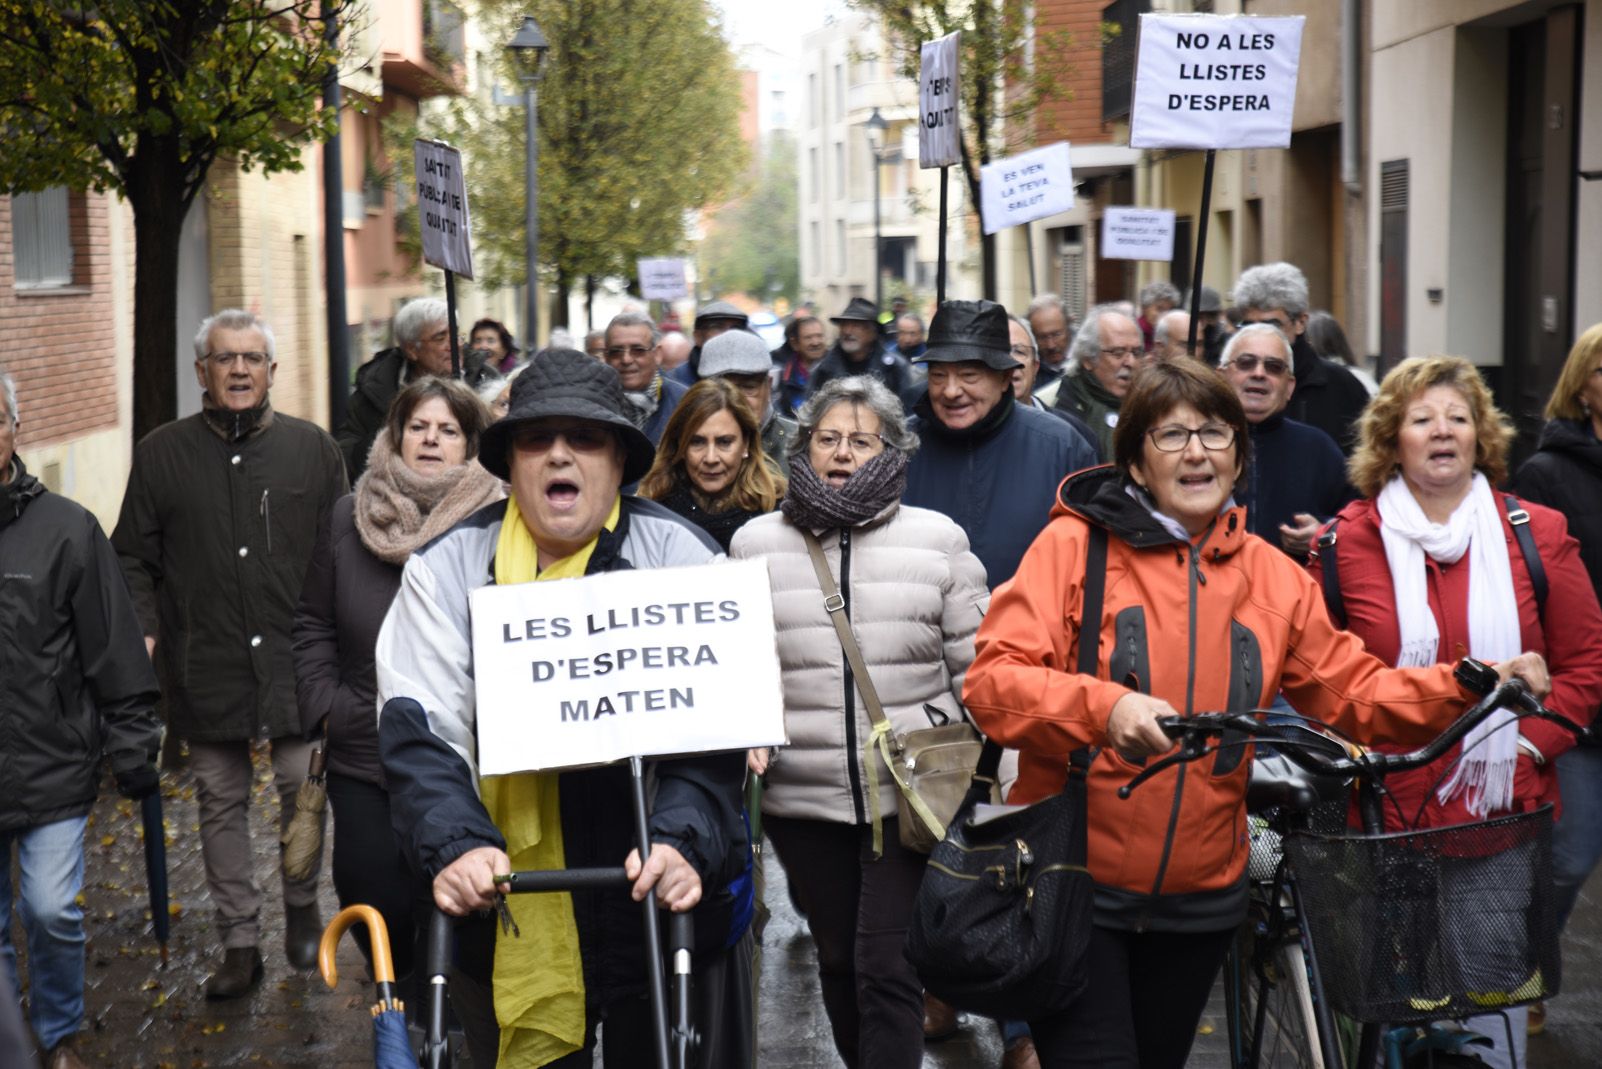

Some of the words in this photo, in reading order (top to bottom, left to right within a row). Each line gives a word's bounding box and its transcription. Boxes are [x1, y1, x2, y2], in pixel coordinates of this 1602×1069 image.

[1177, 33, 1209, 50] NO
[1217, 34, 1232, 50] A
[1239, 34, 1275, 50] LES
[1180, 63, 1266, 81] LLISTES
[1168, 93, 1271, 111] D'ESPERA
[1004, 171, 1017, 182] ES
[1020, 163, 1044, 176] VEN
[1002, 187, 1015, 198] LA
[1018, 178, 1050, 193] TEVA
[1007, 193, 1045, 212] SALUT
[503, 617, 572, 643] LES
[587, 600, 740, 636] LLISTES
[532, 644, 719, 683] D'ESPERA
[560, 687, 695, 722] MATEN
